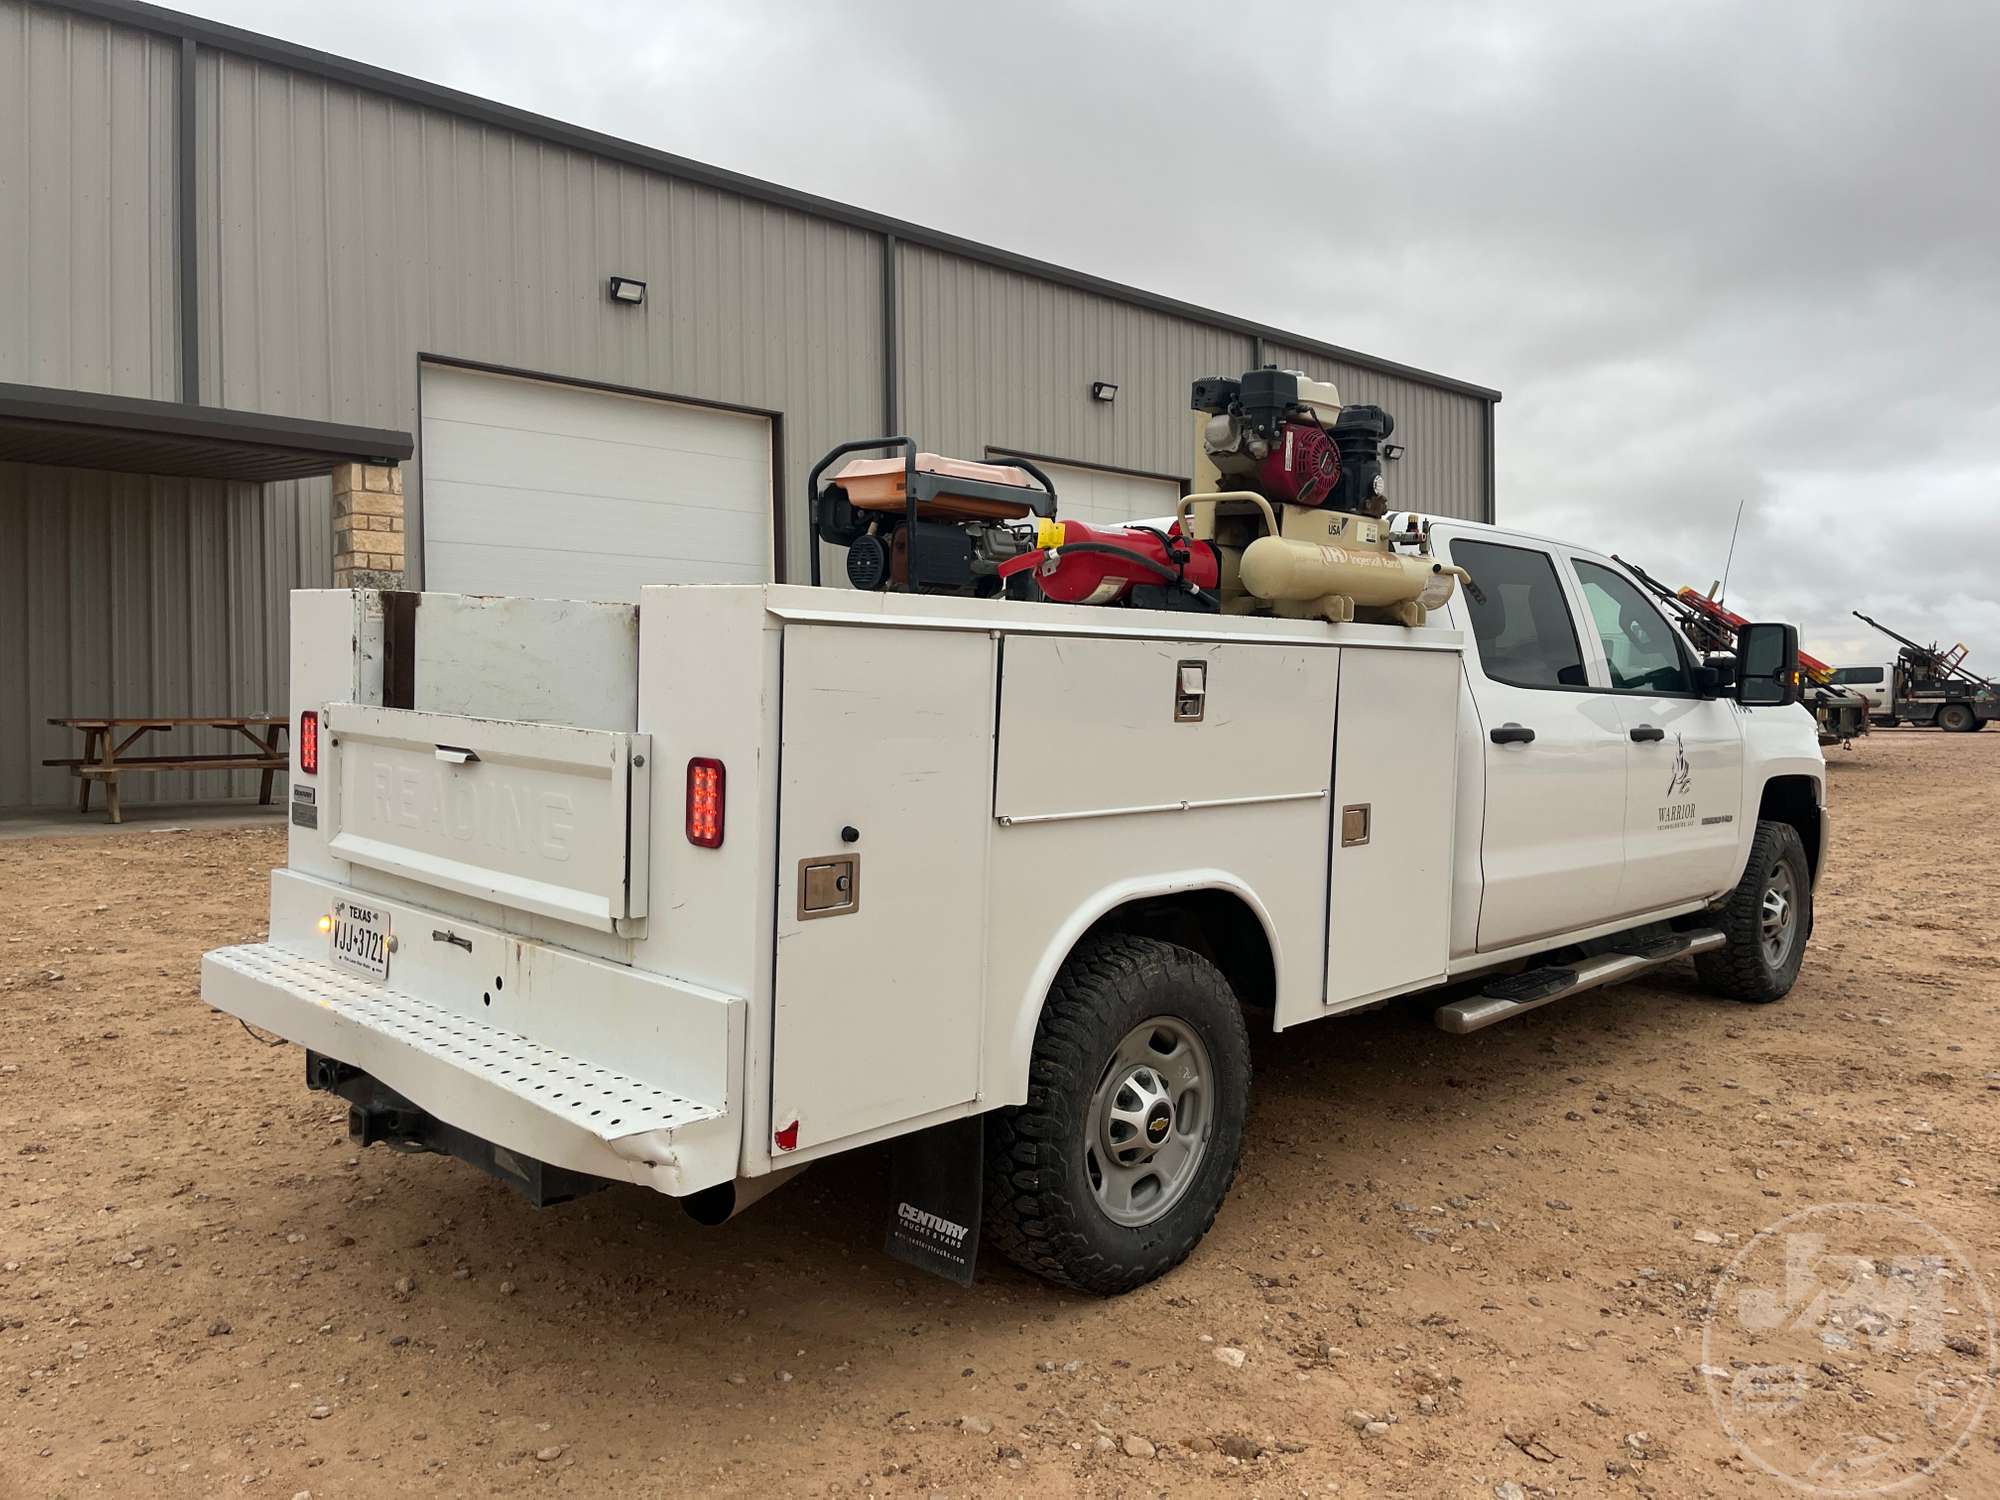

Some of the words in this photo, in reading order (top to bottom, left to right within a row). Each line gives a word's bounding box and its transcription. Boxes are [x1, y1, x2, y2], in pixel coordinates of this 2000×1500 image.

[1328, 523, 1341, 536] USA
[1658, 803, 1696, 822] WARRIOR
[349, 905, 372, 923] TEXAS
[897, 1202, 969, 1240] CENTURY
[899, 1218, 931, 1237] TRUCKS
[940, 1234, 962, 1249] VANS
